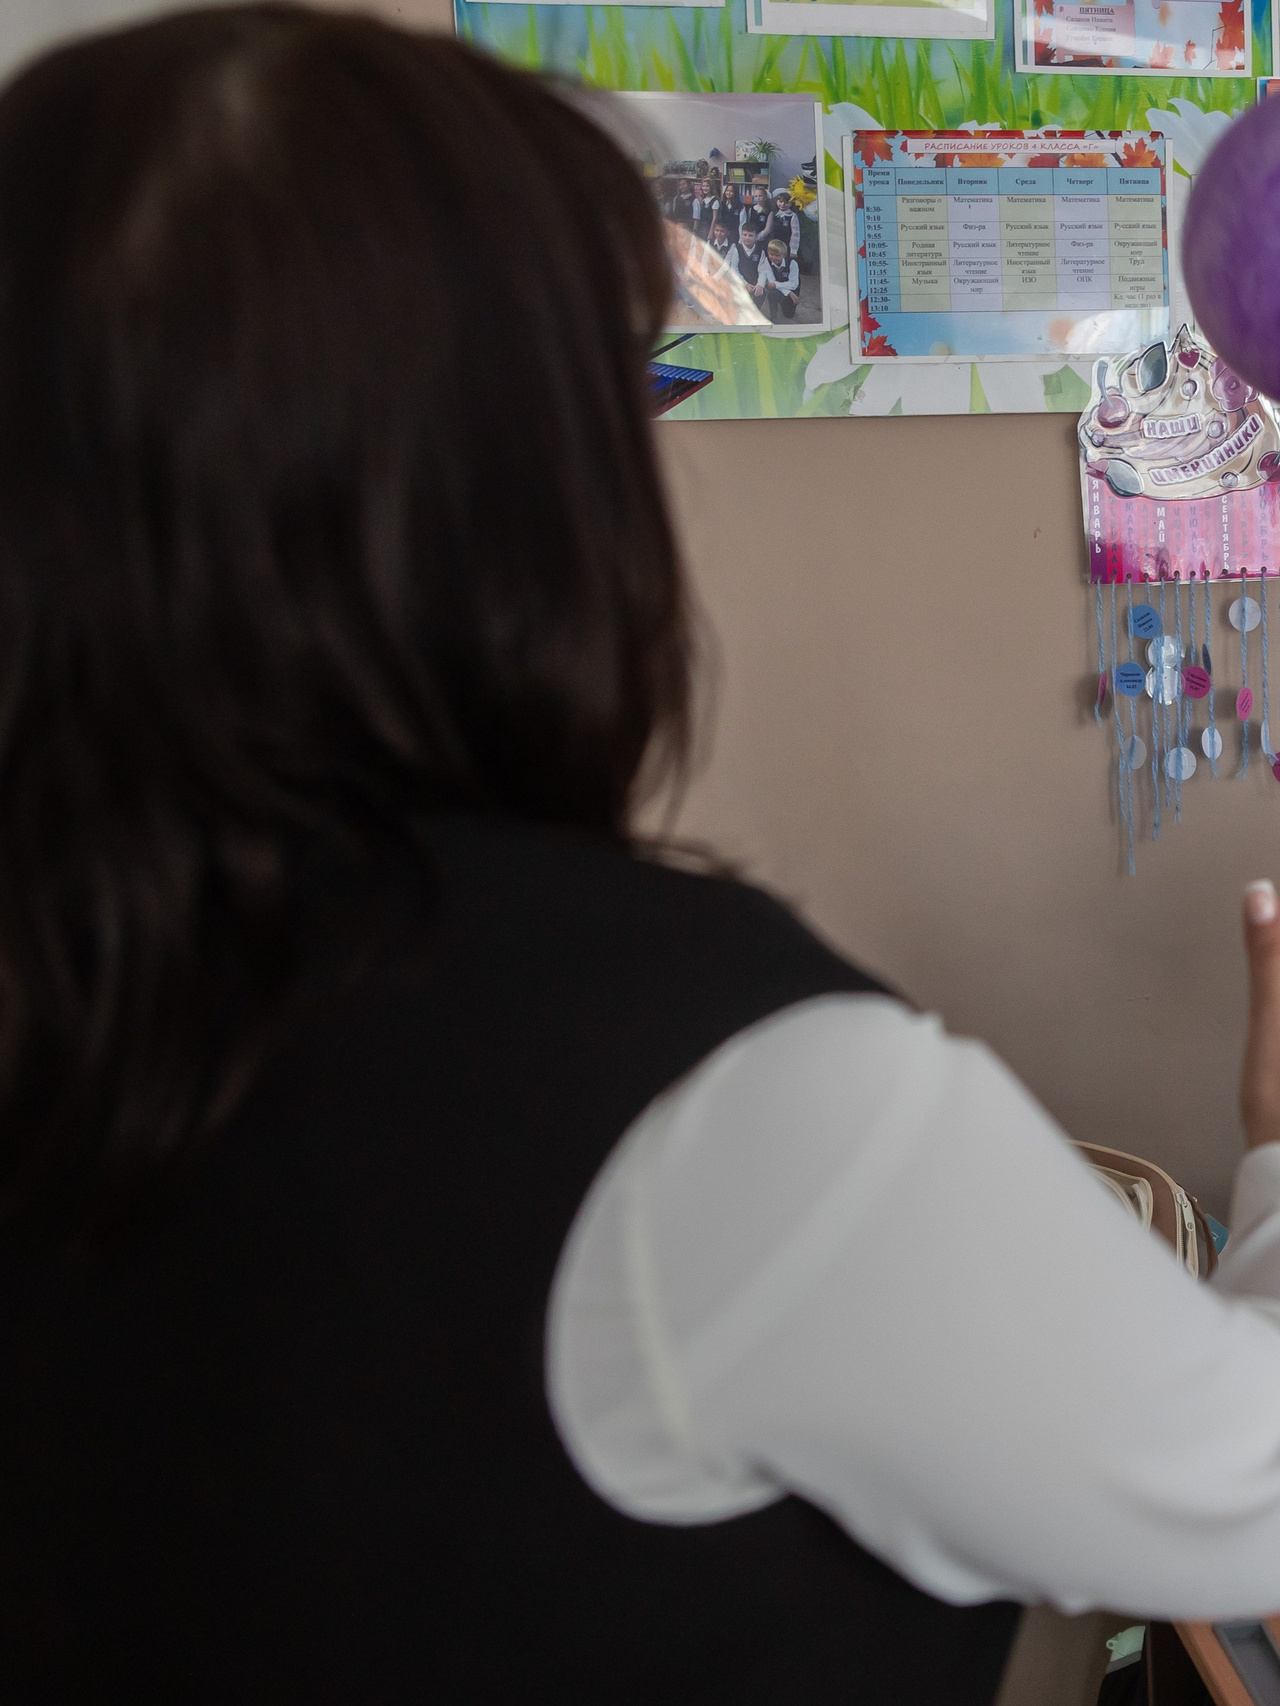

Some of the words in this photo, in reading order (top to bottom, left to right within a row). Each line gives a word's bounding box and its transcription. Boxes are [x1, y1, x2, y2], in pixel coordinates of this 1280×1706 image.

[1079, 7, 1115, 15] ПЯТНИЦА
[924, 142, 988, 150] РАСПИСАНИЕ
[990, 141, 1029, 150] УРОКОВ
[1032, 141, 1037, 149] 4
[1040, 141, 1080, 149] КЛАССА
[1066, 178, 1094, 186] Четверг
[901, 223, 927, 232] Русский
[962, 223, 986, 231] Физ-ра
[1005, 223, 1032, 231] Русский
[1060, 222, 1087, 231] Русский
[1114, 222, 1140, 231] Русский
[953, 241, 980, 249] Русский
[1006, 241, 1050, 249] Литературное
[1070, 240, 1094, 248] Физ-ра
[1114, 240, 1158, 248] Окружающий
[1007, 258, 1051, 266] Иностранный
[1060, 258, 1105, 266] Литературное
[953, 277, 999, 285] Окружающий
[1129, 284, 1145, 292] игры
[1147, 417, 1198, 436] НАШИ
[1151, 416, 1260, 482] ИМЕНИННИКИ
[1092, 479, 1102, 554] ЯНВАРЬ
[1156, 506, 1166, 542] МАЙ
[1221, 495, 1230, 569] СЕНТЯБРЬ
